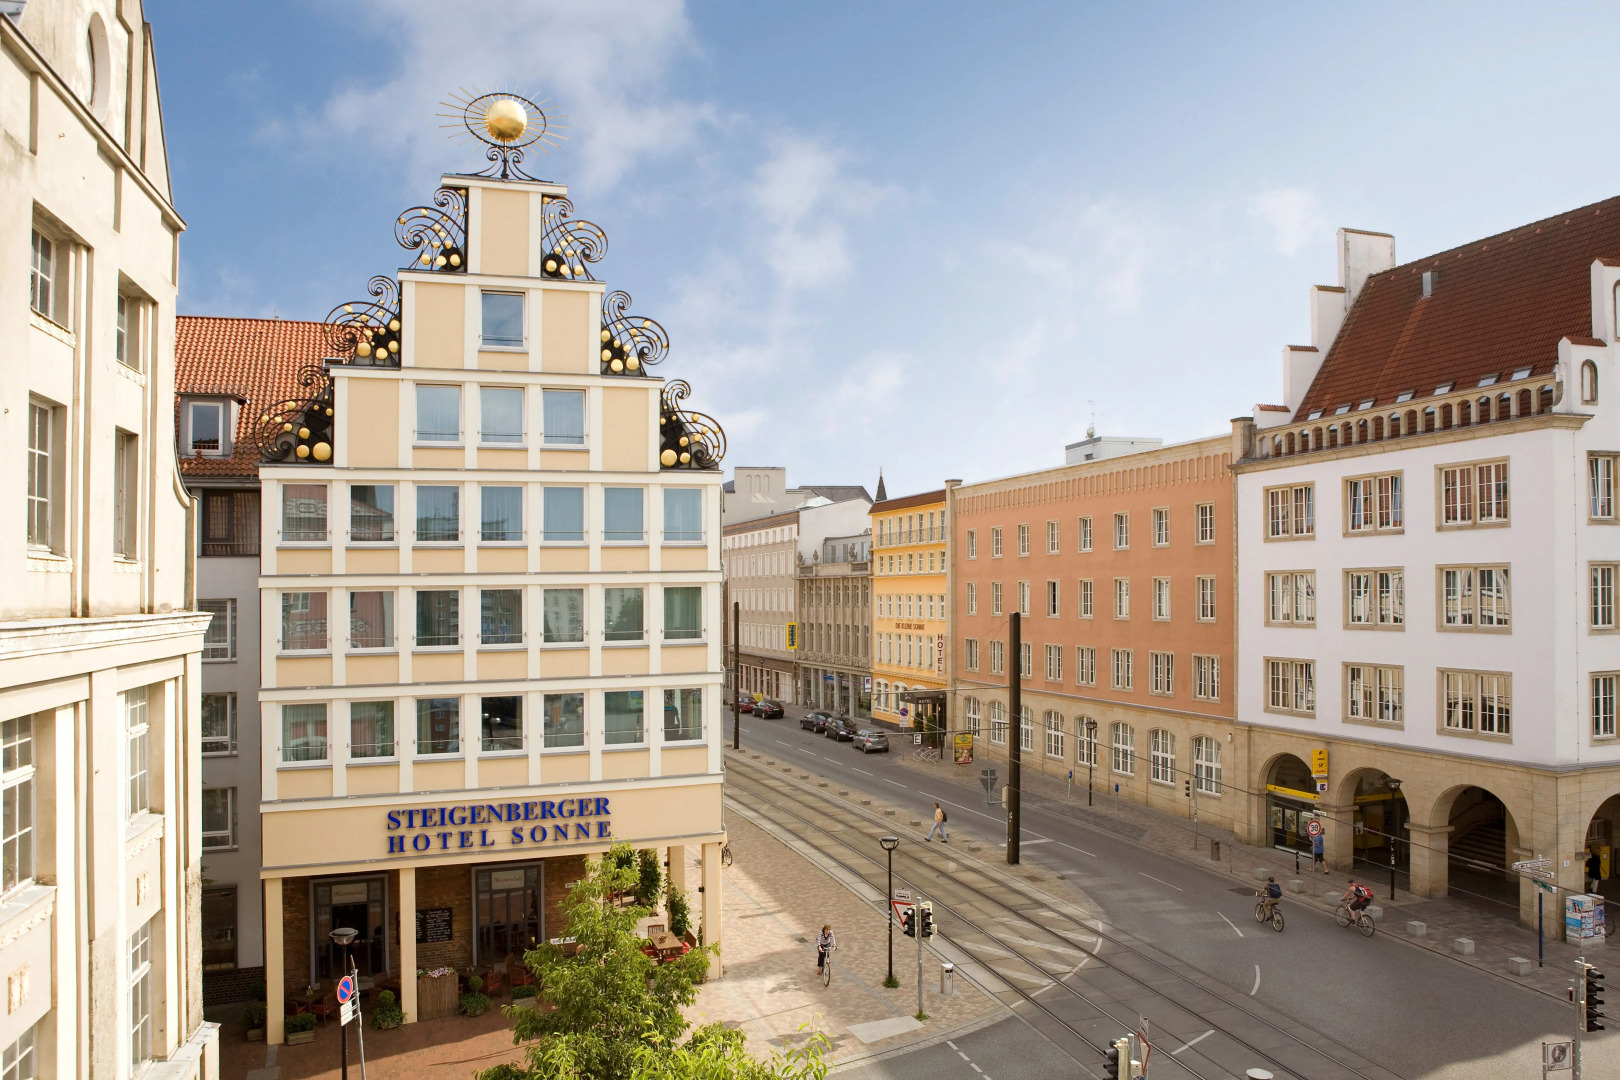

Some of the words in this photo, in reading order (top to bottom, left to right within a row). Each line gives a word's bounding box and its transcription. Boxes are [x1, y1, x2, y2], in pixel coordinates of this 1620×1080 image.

[387, 797, 611, 831] STEIGENBERGER
[1310, 824, 1319, 832] 30
[387, 829, 495, 854] HOTEL
[511, 821, 611, 845] SONNE
